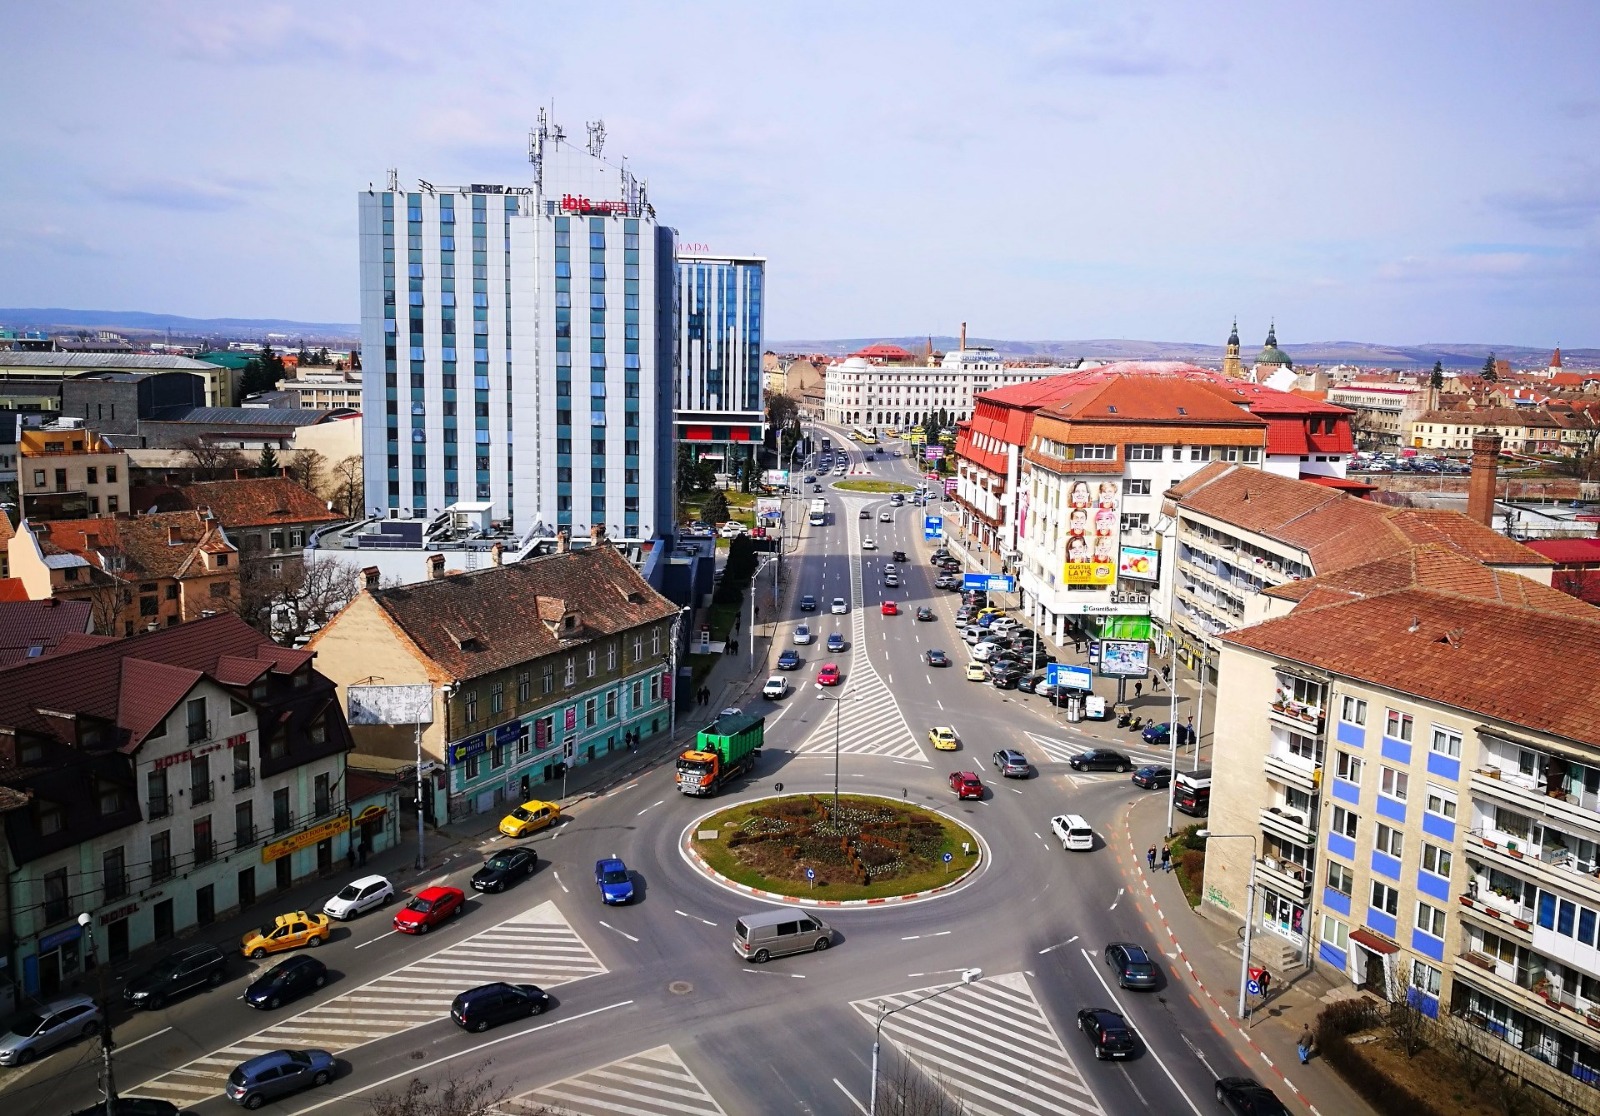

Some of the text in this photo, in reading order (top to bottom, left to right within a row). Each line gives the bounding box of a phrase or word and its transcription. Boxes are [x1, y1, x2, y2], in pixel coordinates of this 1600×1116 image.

[562, 194, 591, 211] ibis
[154, 733, 247, 769] HOTEL BIN
[466, 741, 484, 752] HOTEL
[295, 831, 309, 842] FAST
[309, 827, 324, 837] FOOD
[336, 824, 348, 833] STOP
[101, 903, 140, 926] HOTEL
